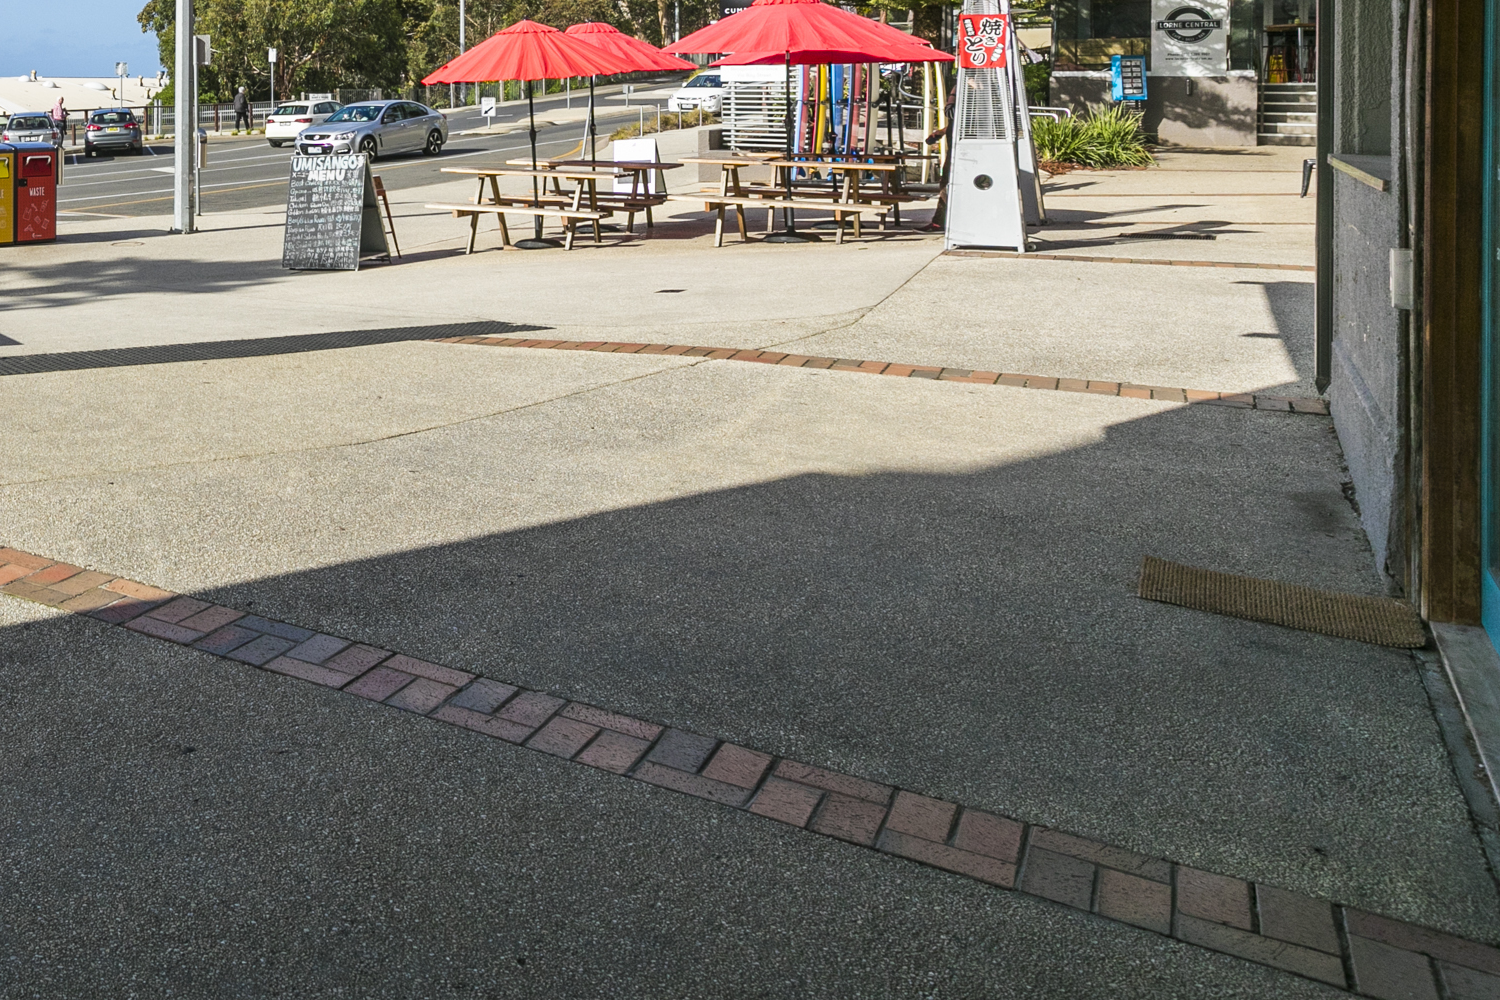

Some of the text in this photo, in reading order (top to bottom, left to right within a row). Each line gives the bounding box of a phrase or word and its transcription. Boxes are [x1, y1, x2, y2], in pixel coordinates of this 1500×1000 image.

[293, 156, 357, 171] UMISANGO
[308, 169, 346, 181] MENU
[29, 187, 45, 196] WASTE
